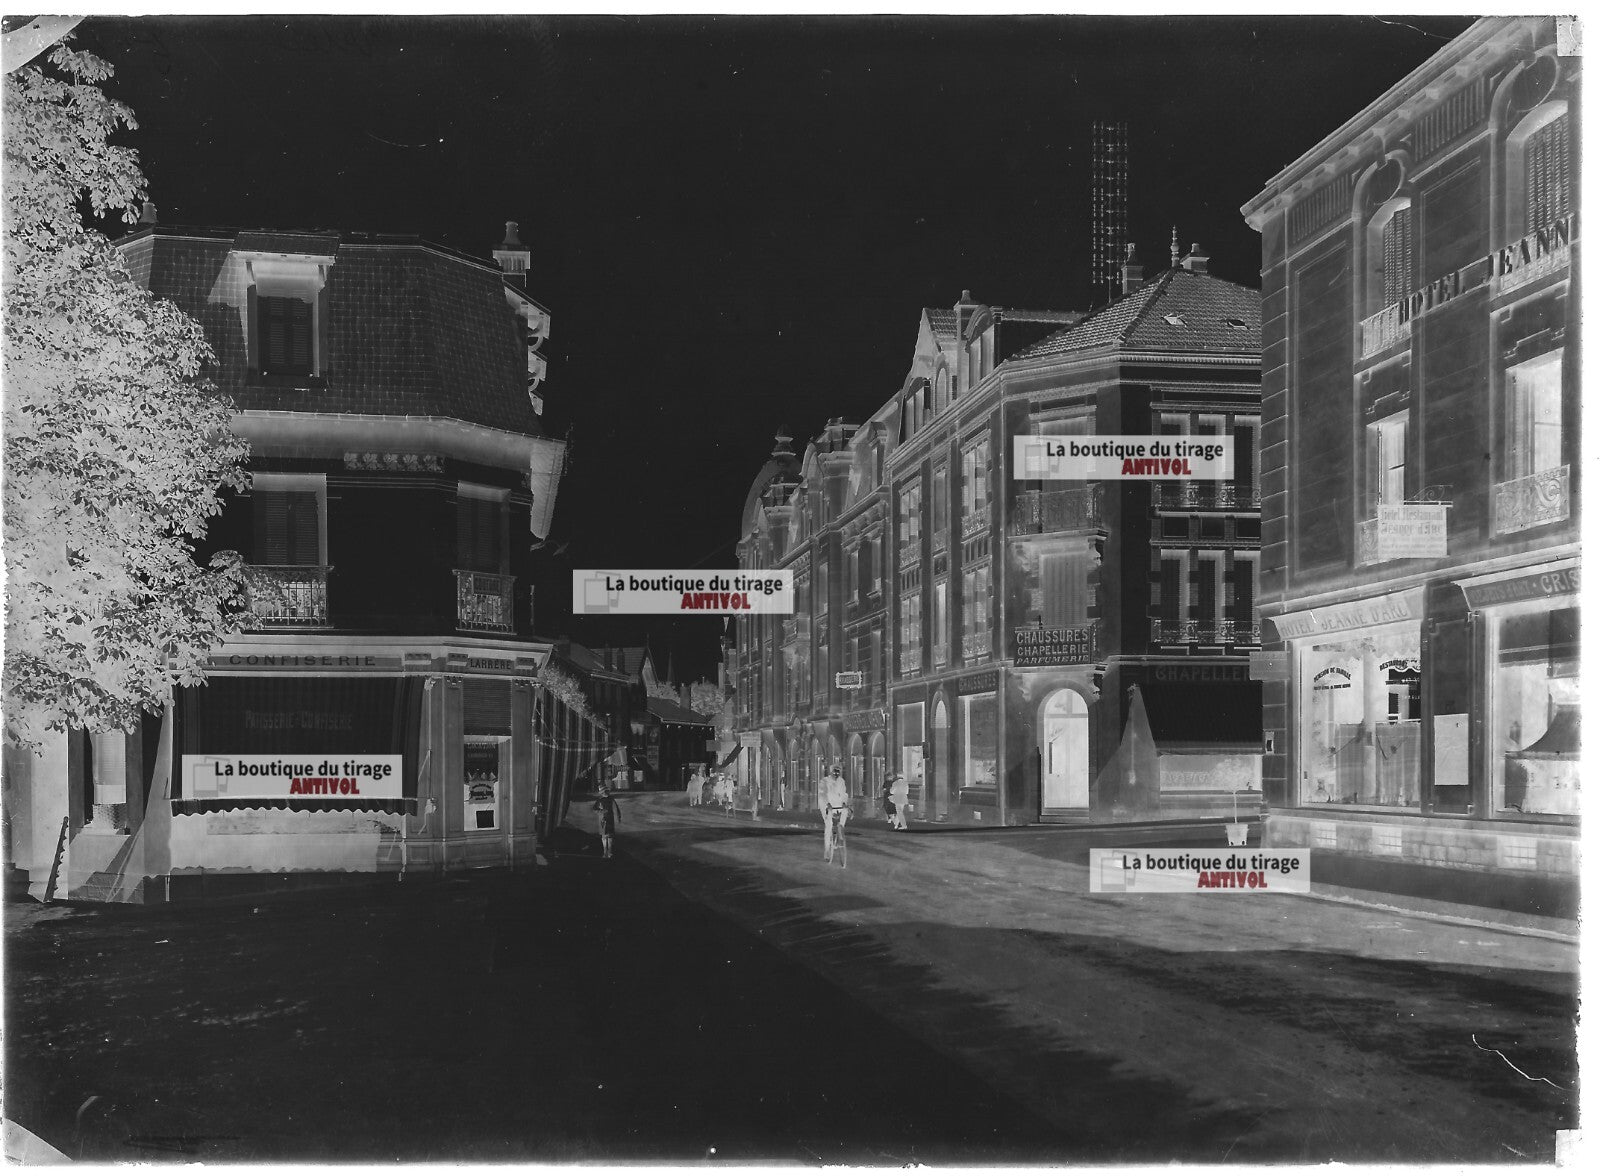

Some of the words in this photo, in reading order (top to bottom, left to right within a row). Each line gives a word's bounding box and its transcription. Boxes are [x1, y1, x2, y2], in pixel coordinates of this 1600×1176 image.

[1399, 270, 1466, 326] HOTEL
[1280, 622, 1314, 637] HOTEL
[1321, 613, 1367, 631] JEANNE
[1371, 599, 1408, 621] D'ARC
[1016, 629, 1088, 644] CHAUSSURES
[1017, 643, 1088, 656] CHAPELLERIE
[229, 654, 376, 666] CONFISERIE
[1016, 655, 1089, 665] PARFUMERIE
